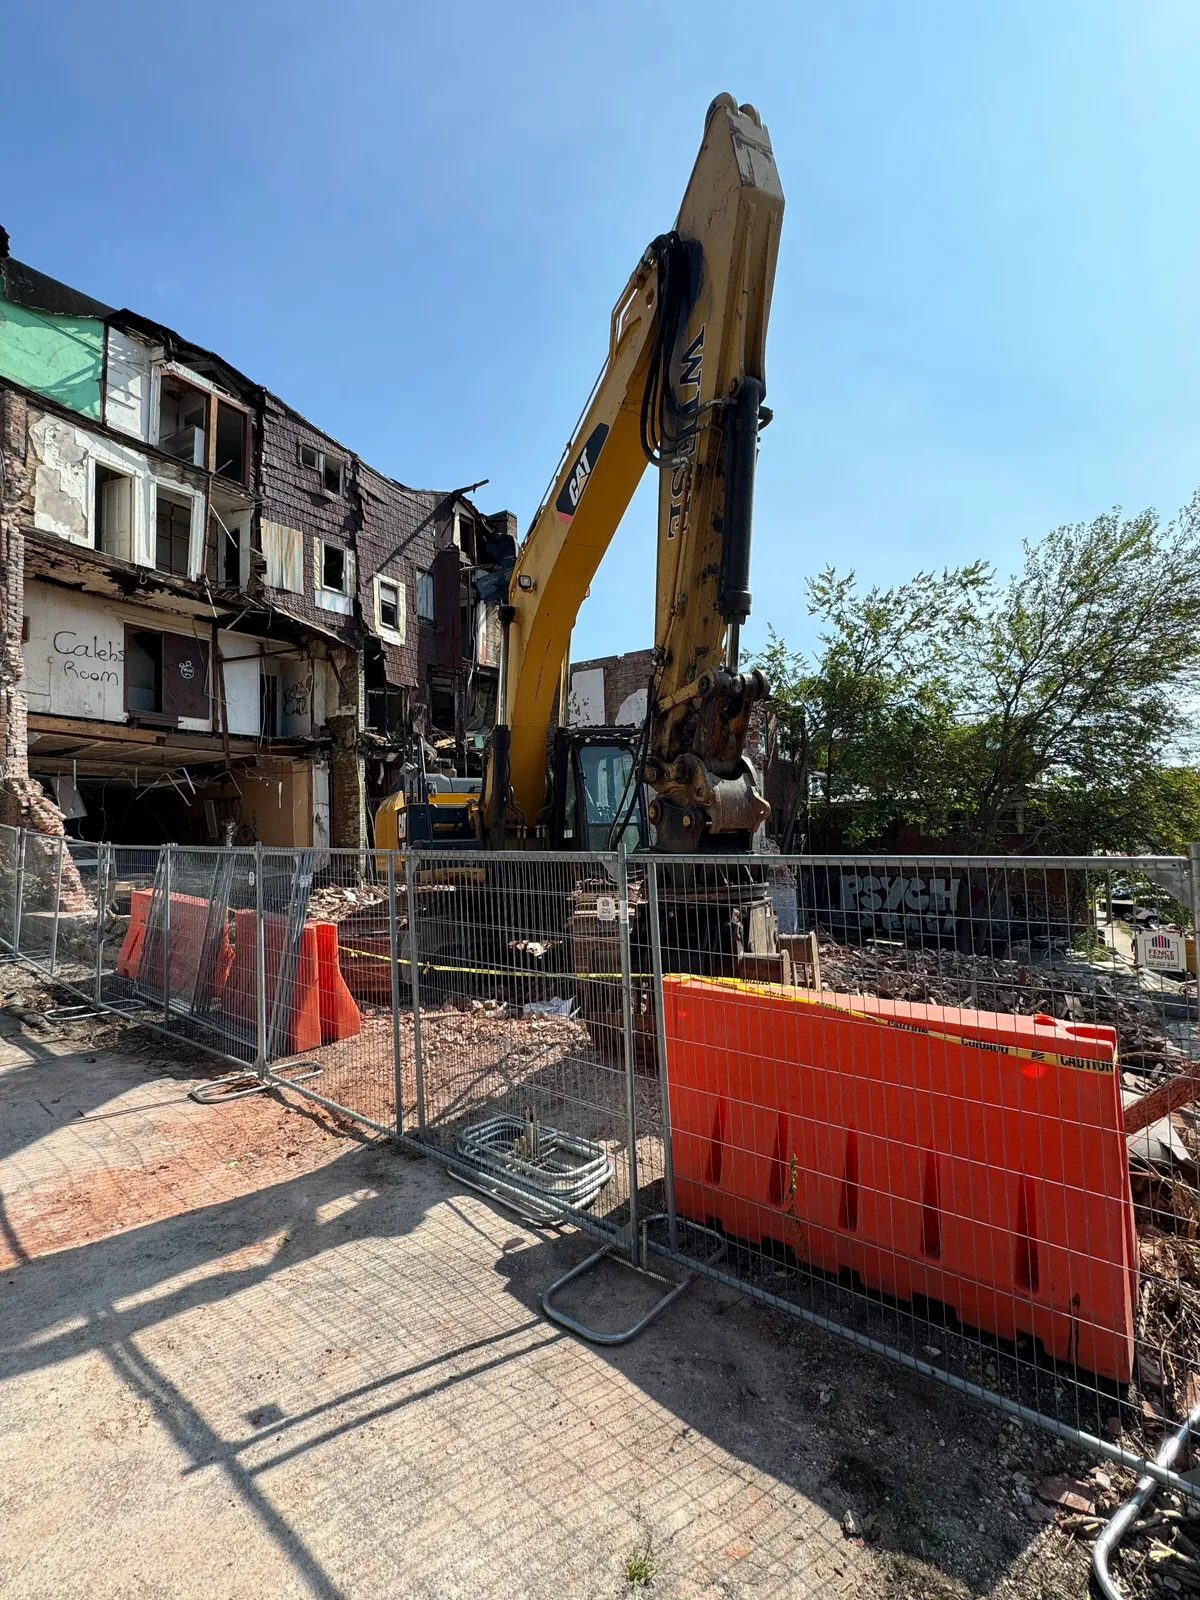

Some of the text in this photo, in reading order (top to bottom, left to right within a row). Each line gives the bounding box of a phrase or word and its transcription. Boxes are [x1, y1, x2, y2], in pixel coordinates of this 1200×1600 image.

[569, 446, 591, 507] CAT
[63, 660, 119, 687] Room
[839, 874, 961, 911] PSYCH
[1148, 949, 1175, 957] FENCE
